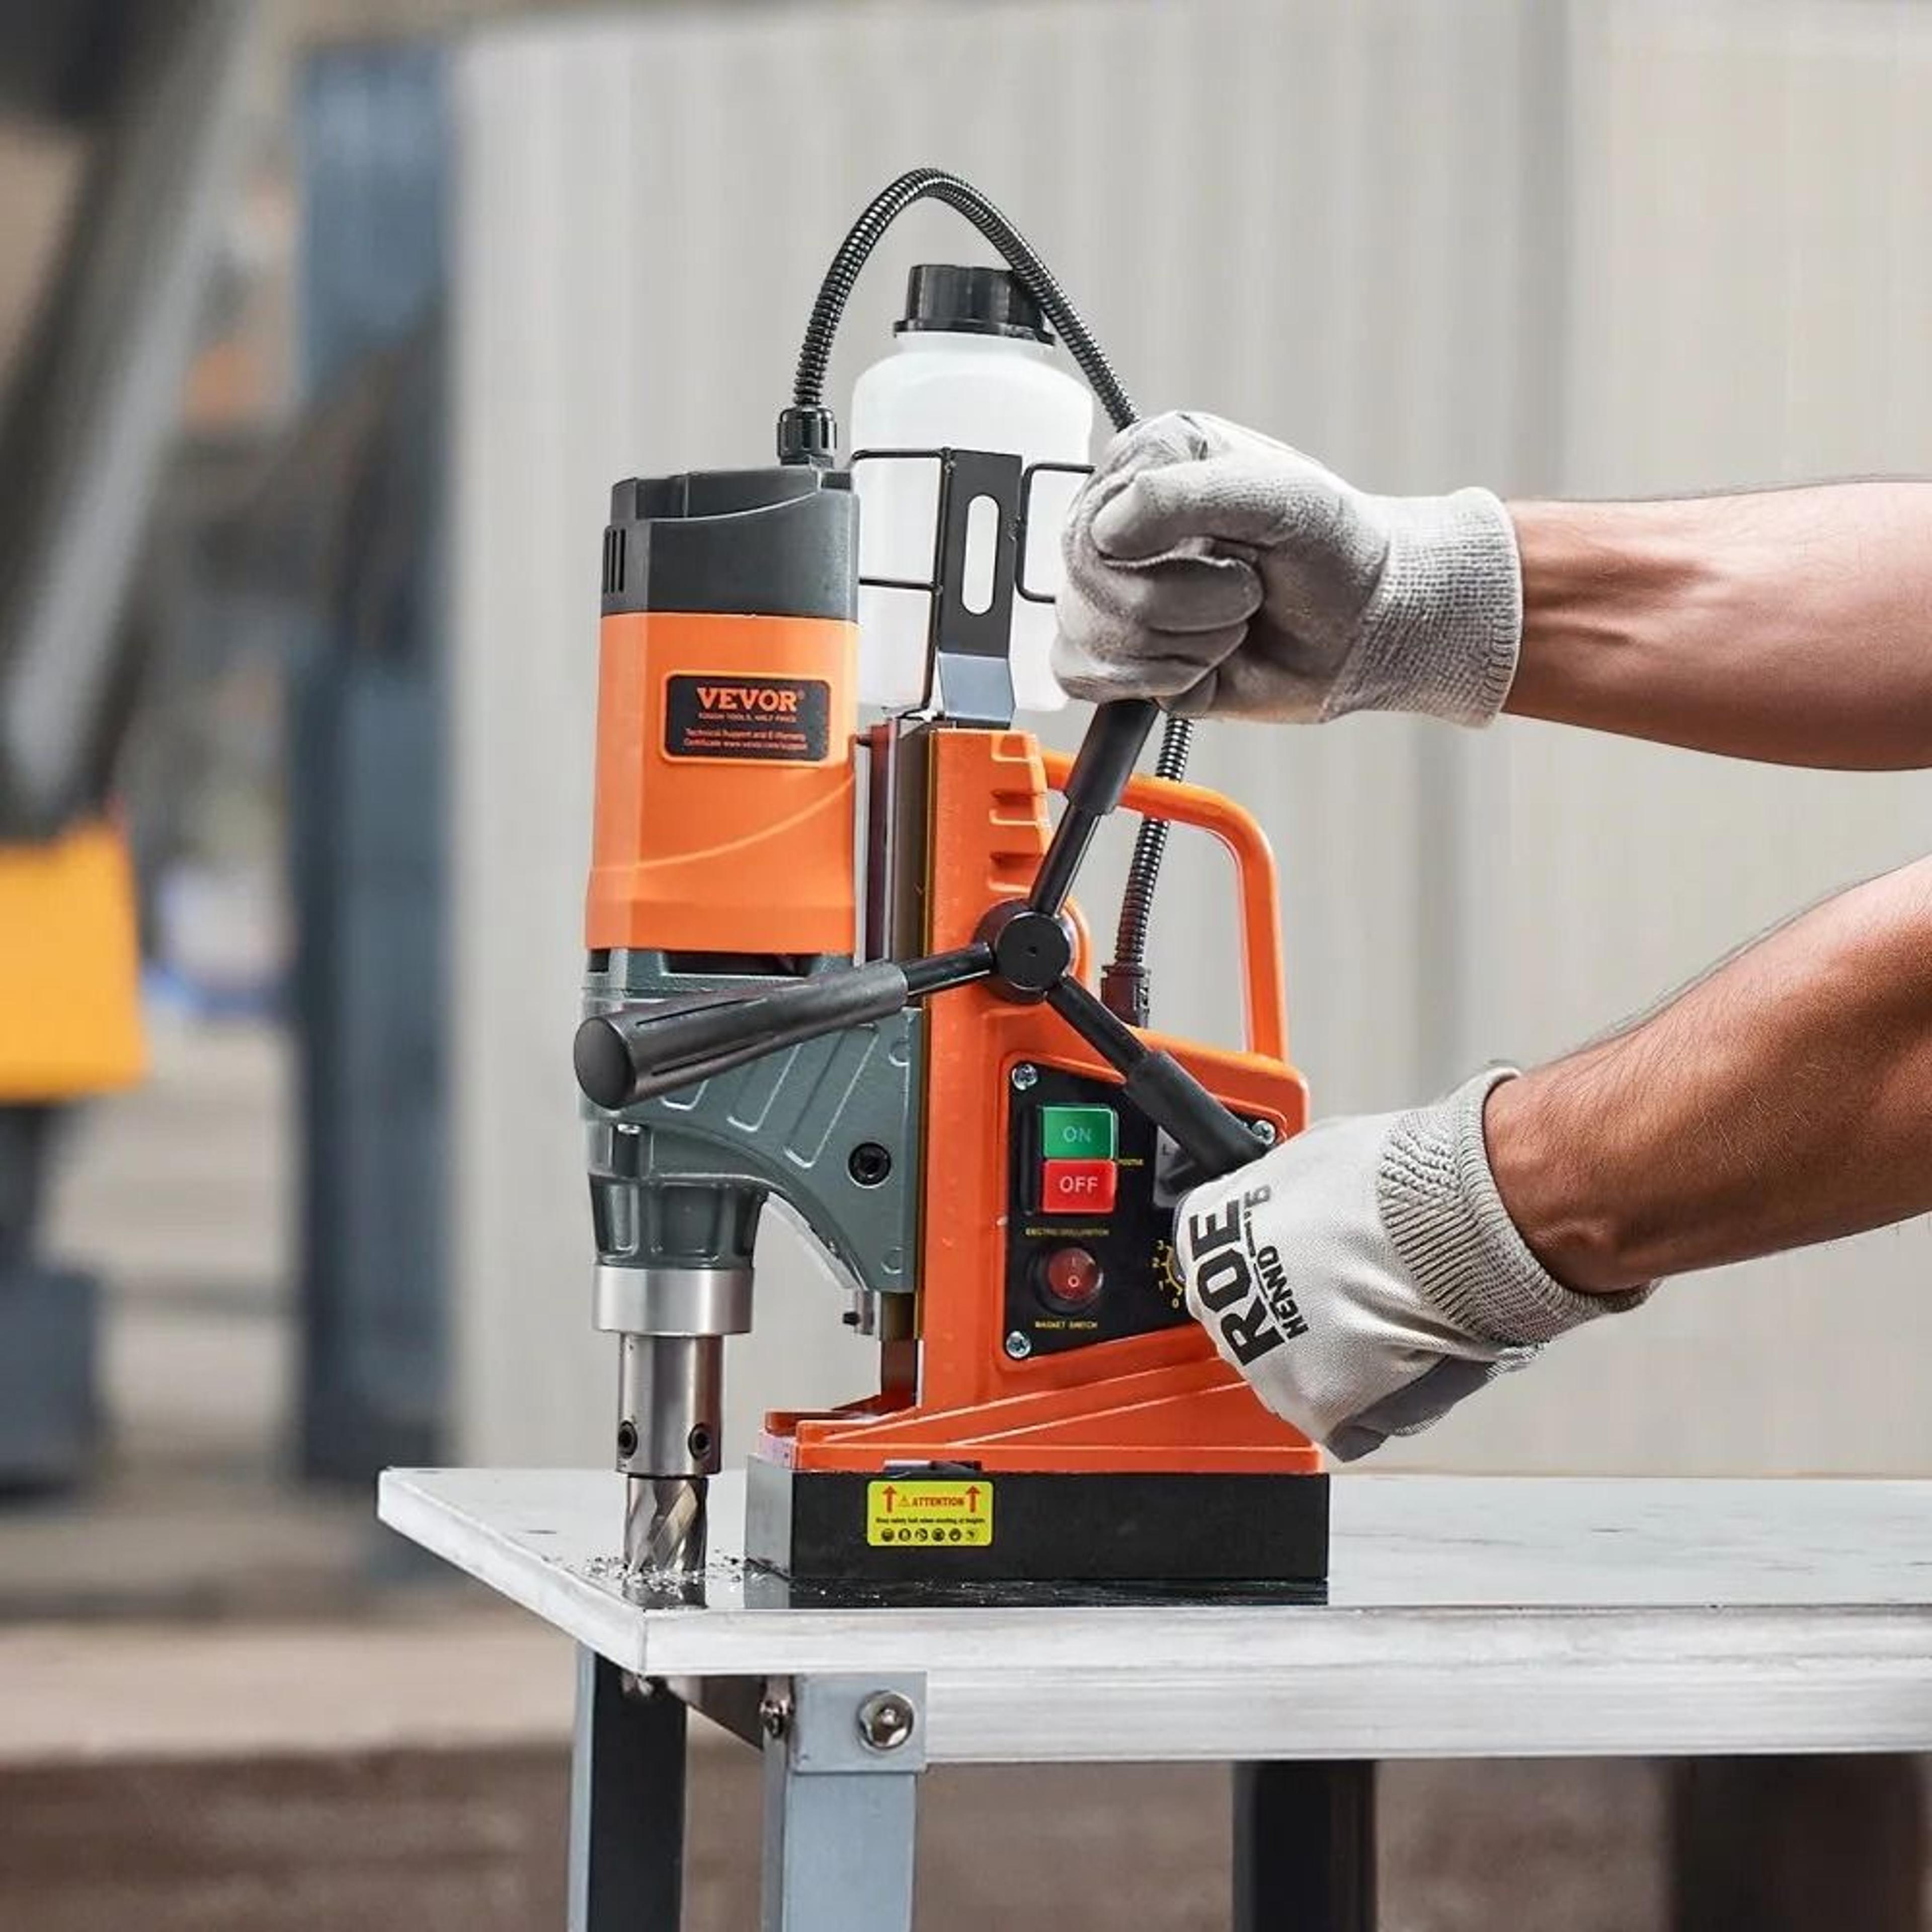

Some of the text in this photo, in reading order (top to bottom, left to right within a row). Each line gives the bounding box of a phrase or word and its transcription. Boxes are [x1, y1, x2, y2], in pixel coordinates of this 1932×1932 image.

[697, 687, 797, 712] VEVOR
[1063, 1125, 1092, 1143] ON
[1060, 1176, 1098, 1193] OFF
[1188, 1199, 1286, 1366] ROE
[912, 1497, 965, 1507] ATTENTION
